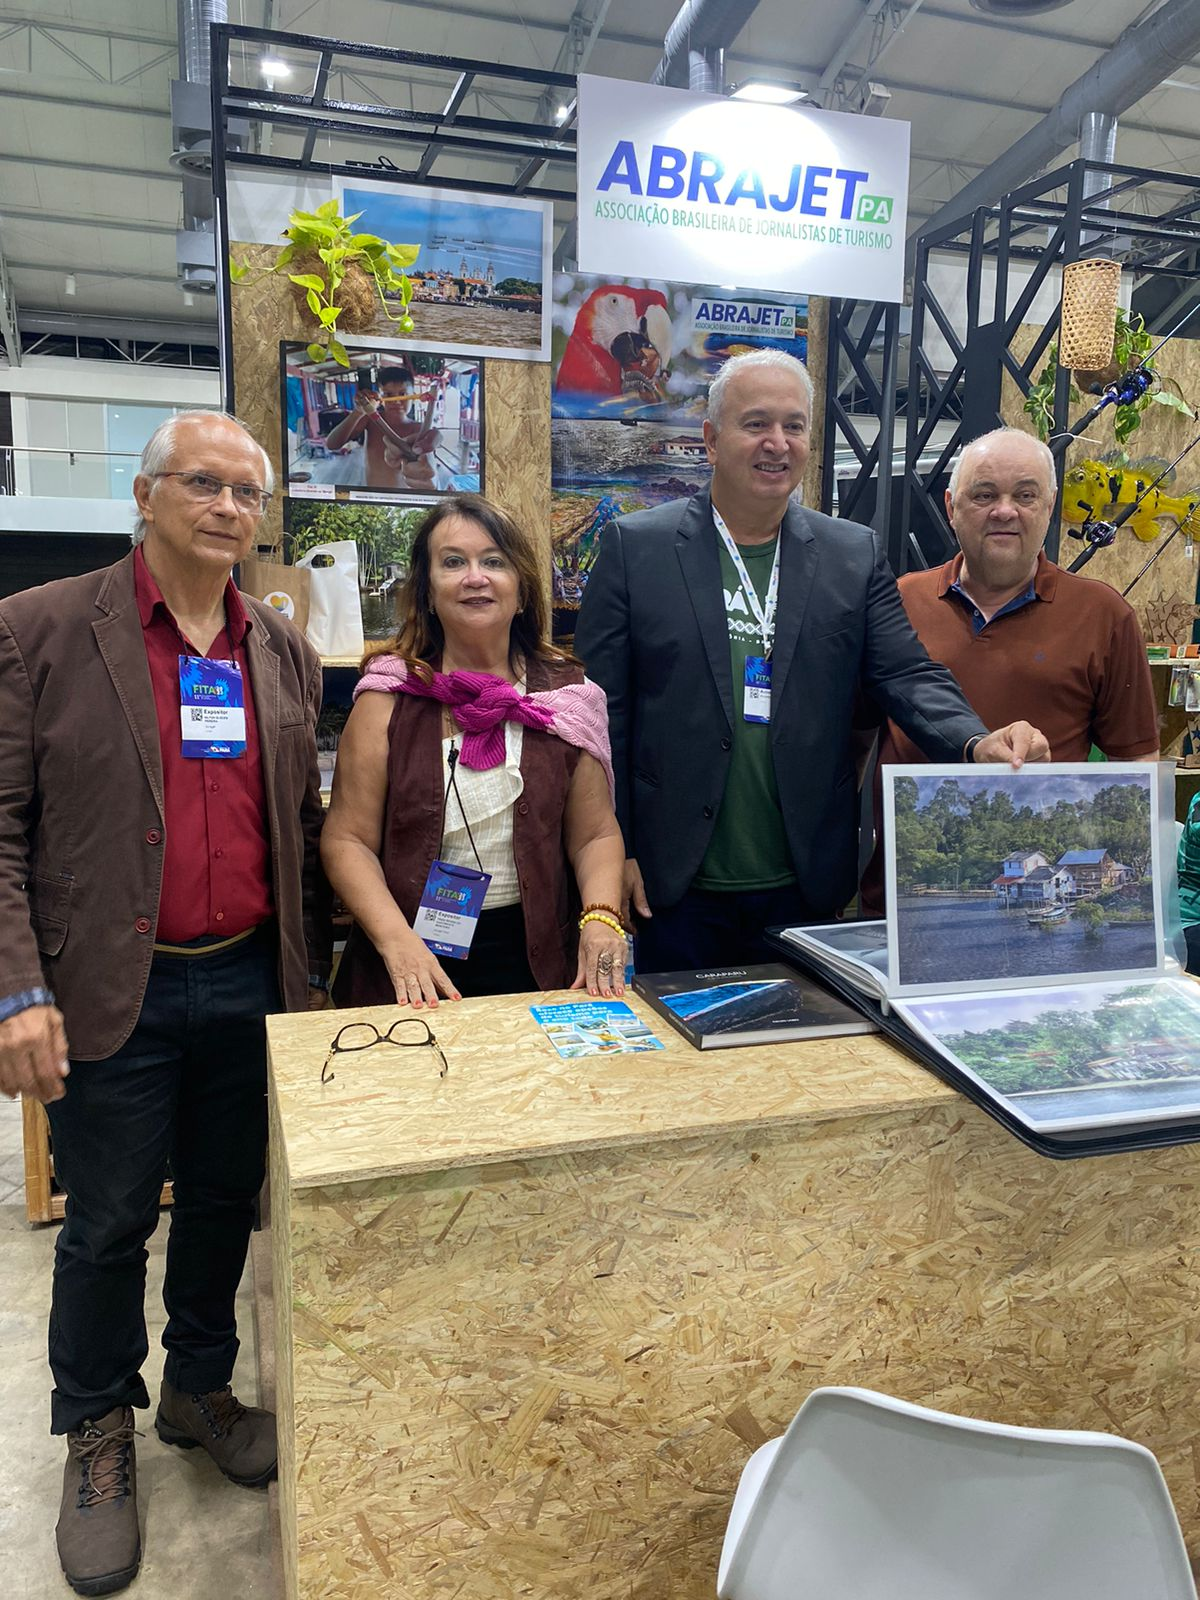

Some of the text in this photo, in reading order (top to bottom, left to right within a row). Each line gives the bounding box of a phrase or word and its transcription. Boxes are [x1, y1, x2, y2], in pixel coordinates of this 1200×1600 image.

[596, 140, 891, 222] ABRAJET PA
[594, 200, 893, 250] ASSOCIAÇÃO BRASILEIRA DE JORNALISTAS DE TURISMO
[695, 302, 784, 326] ABRAJET
